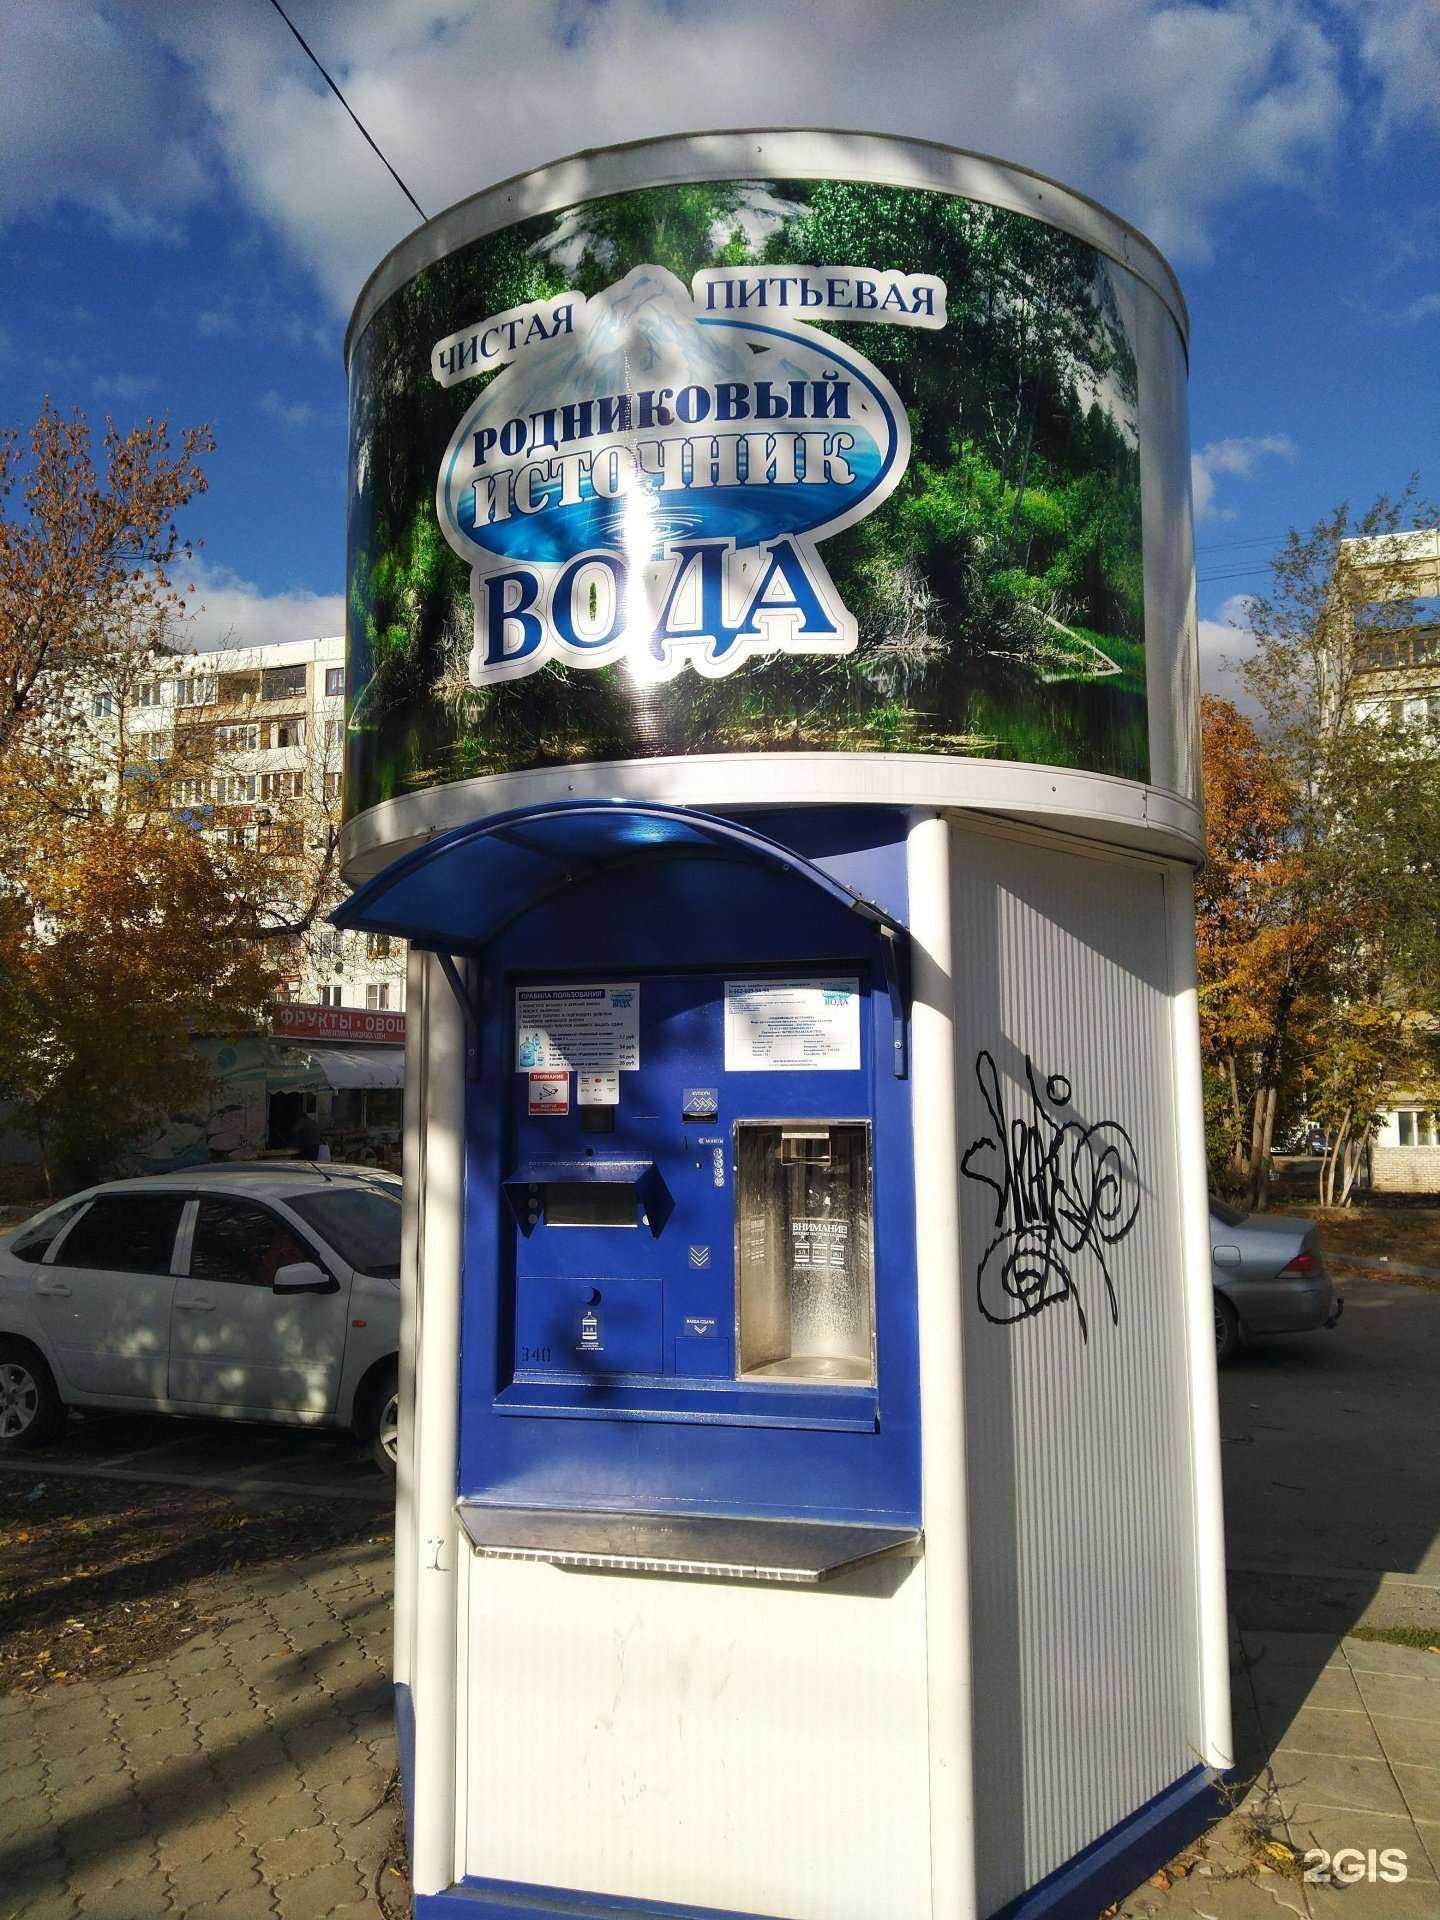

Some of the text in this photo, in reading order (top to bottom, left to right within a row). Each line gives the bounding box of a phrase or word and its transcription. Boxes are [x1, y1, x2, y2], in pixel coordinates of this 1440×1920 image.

[705, 278, 937, 317] ПИТЬЕВАЯ
[438, 303, 576, 376] ЧИСТАЯ
[472, 369, 852, 468] РОДНИКОВЫЙ
[471, 431, 856, 529] ИСТОЧНИК
[482, 535, 838, 667] ВОДА
[280, 1009, 352, 1029] ФРУКТЫ
[521, 990, 602, 1000] ПРАВИЛА ПОЛЬЗОВАНИЯ
